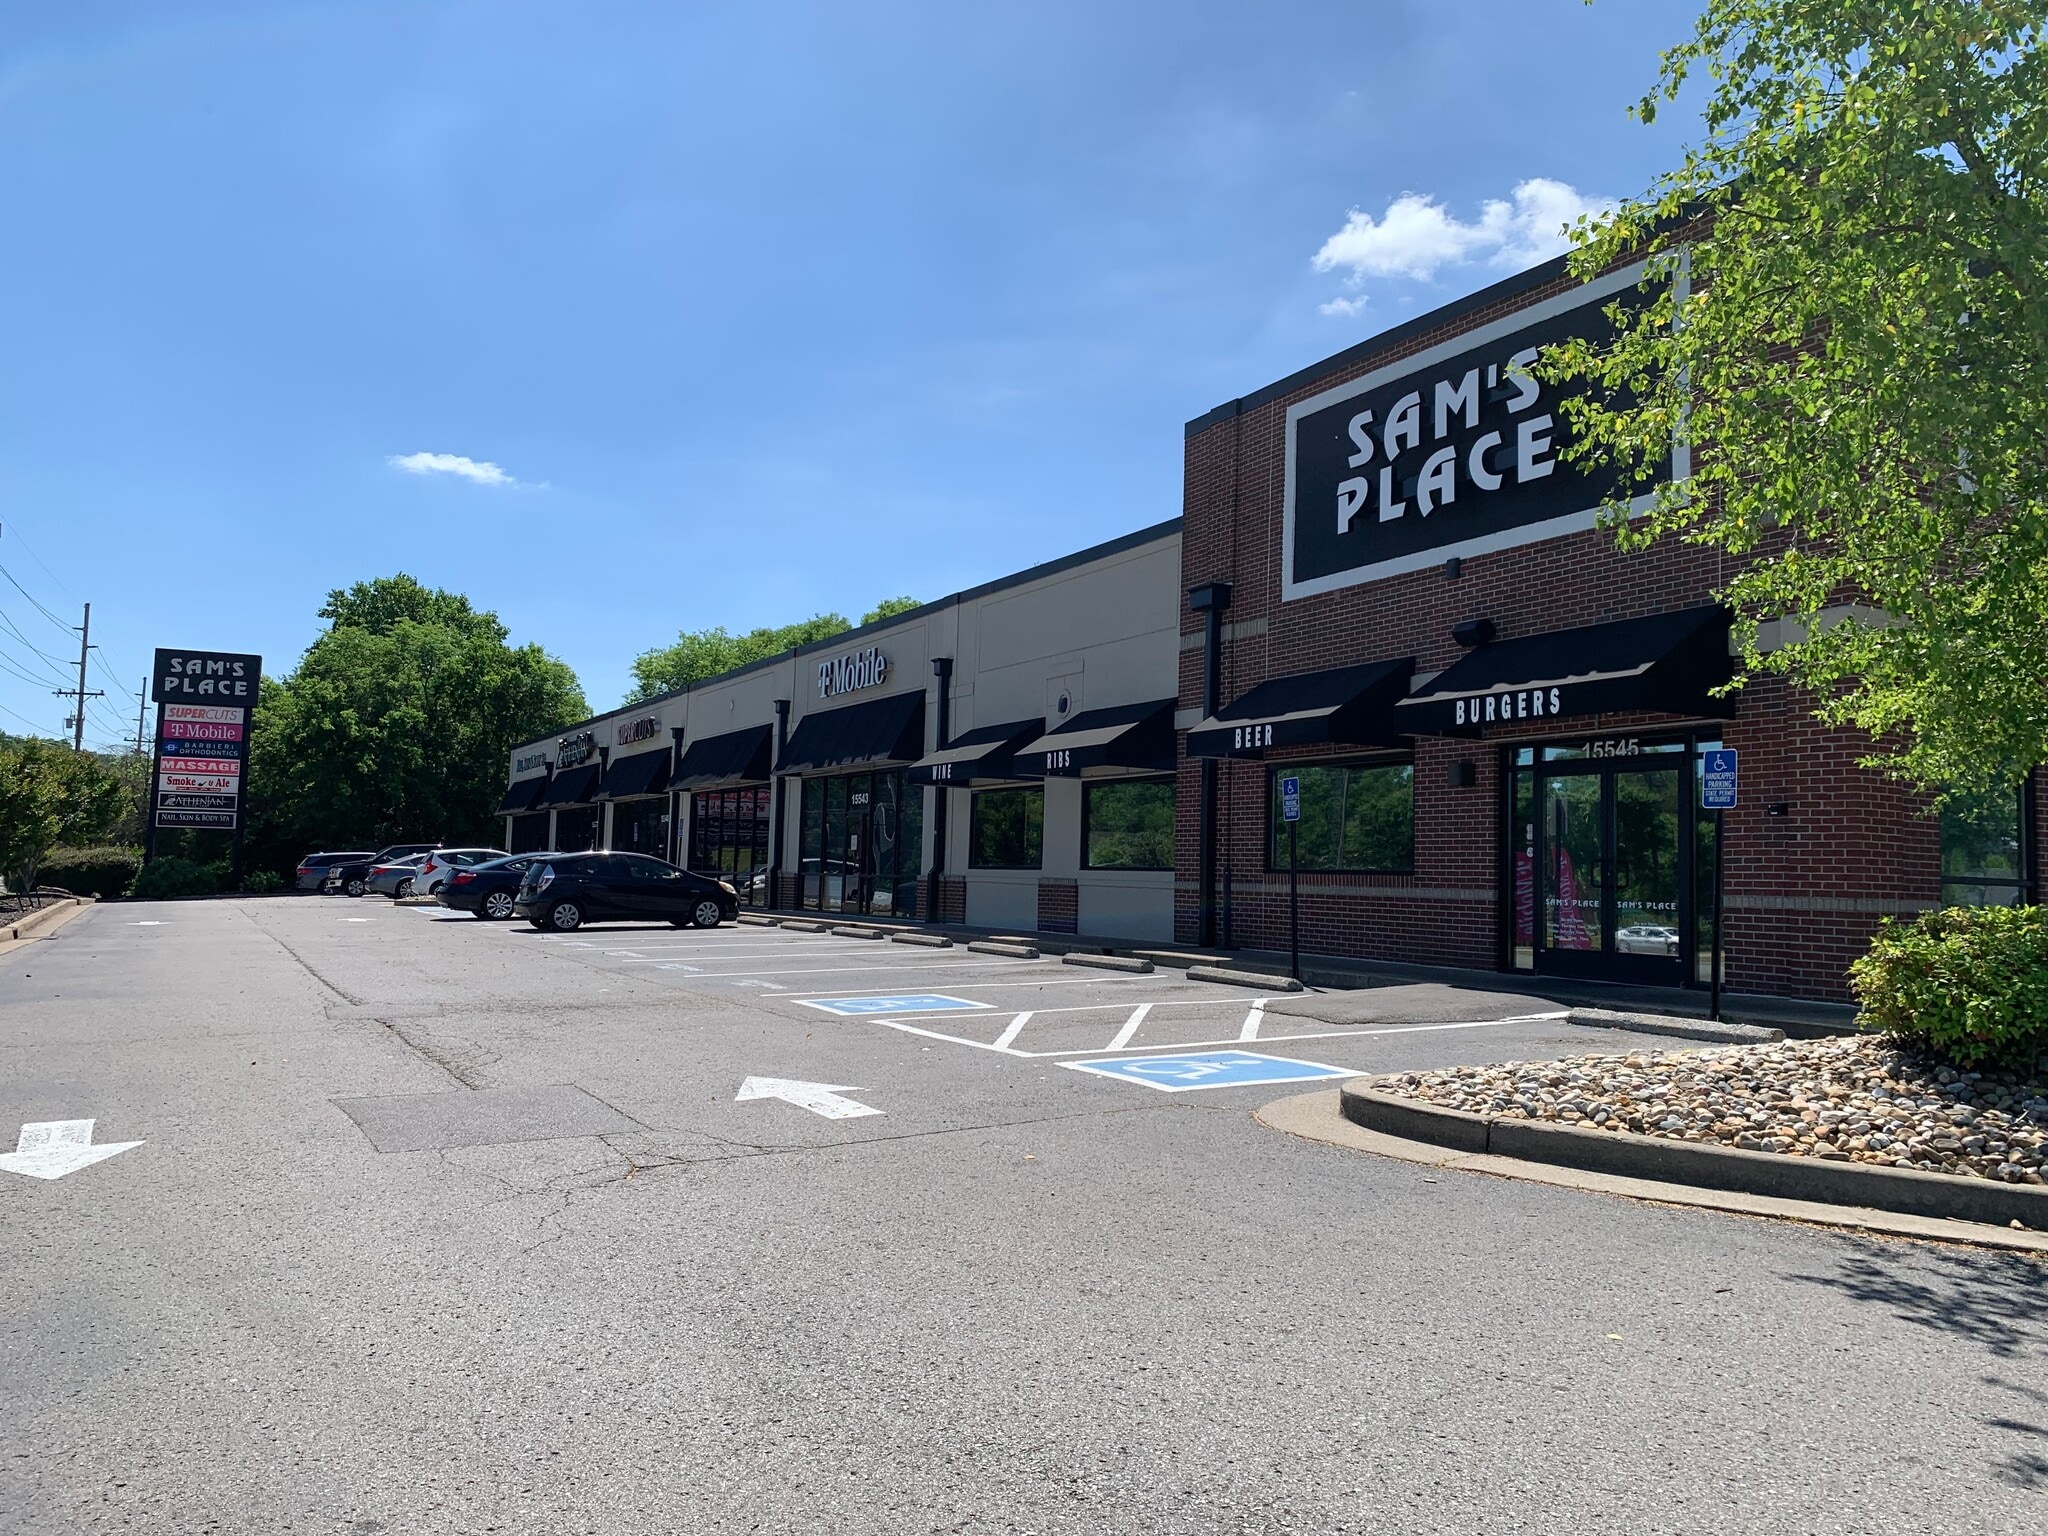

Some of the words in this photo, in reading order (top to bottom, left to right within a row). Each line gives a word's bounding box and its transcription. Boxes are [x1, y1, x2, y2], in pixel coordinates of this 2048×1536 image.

[1348, 346, 1540, 468] SAM'S
[1337, 414, 1556, 534] PLACE
[170, 658, 245, 676] SAM'S
[164, 677, 248, 695] PLACE
[1456, 688, 1560, 725] BURGERS
[168, 708, 237, 720] SUPERCUTS
[1235, 725, 1272, 749] BEER
[180, 748, 239, 756] ORTHODONTICS
[185, 742, 234, 750] BARBIERI
[1582, 739, 1639, 758] 15545
[162, 760, 239, 771] MASSAGE
[1047, 750, 1070, 769] RIBS
[932, 764, 952, 780] WINE
[167, 776, 196, 786] Smoke
[215, 778, 230, 787] Ale
[851, 793, 869, 805] 15543
[201, 814, 219, 822] BODY
[1572, 899, 1600, 908] PLACE
[1617, 901, 1643, 909] SAM'S
[1646, 902, 1677, 910] PLACE
